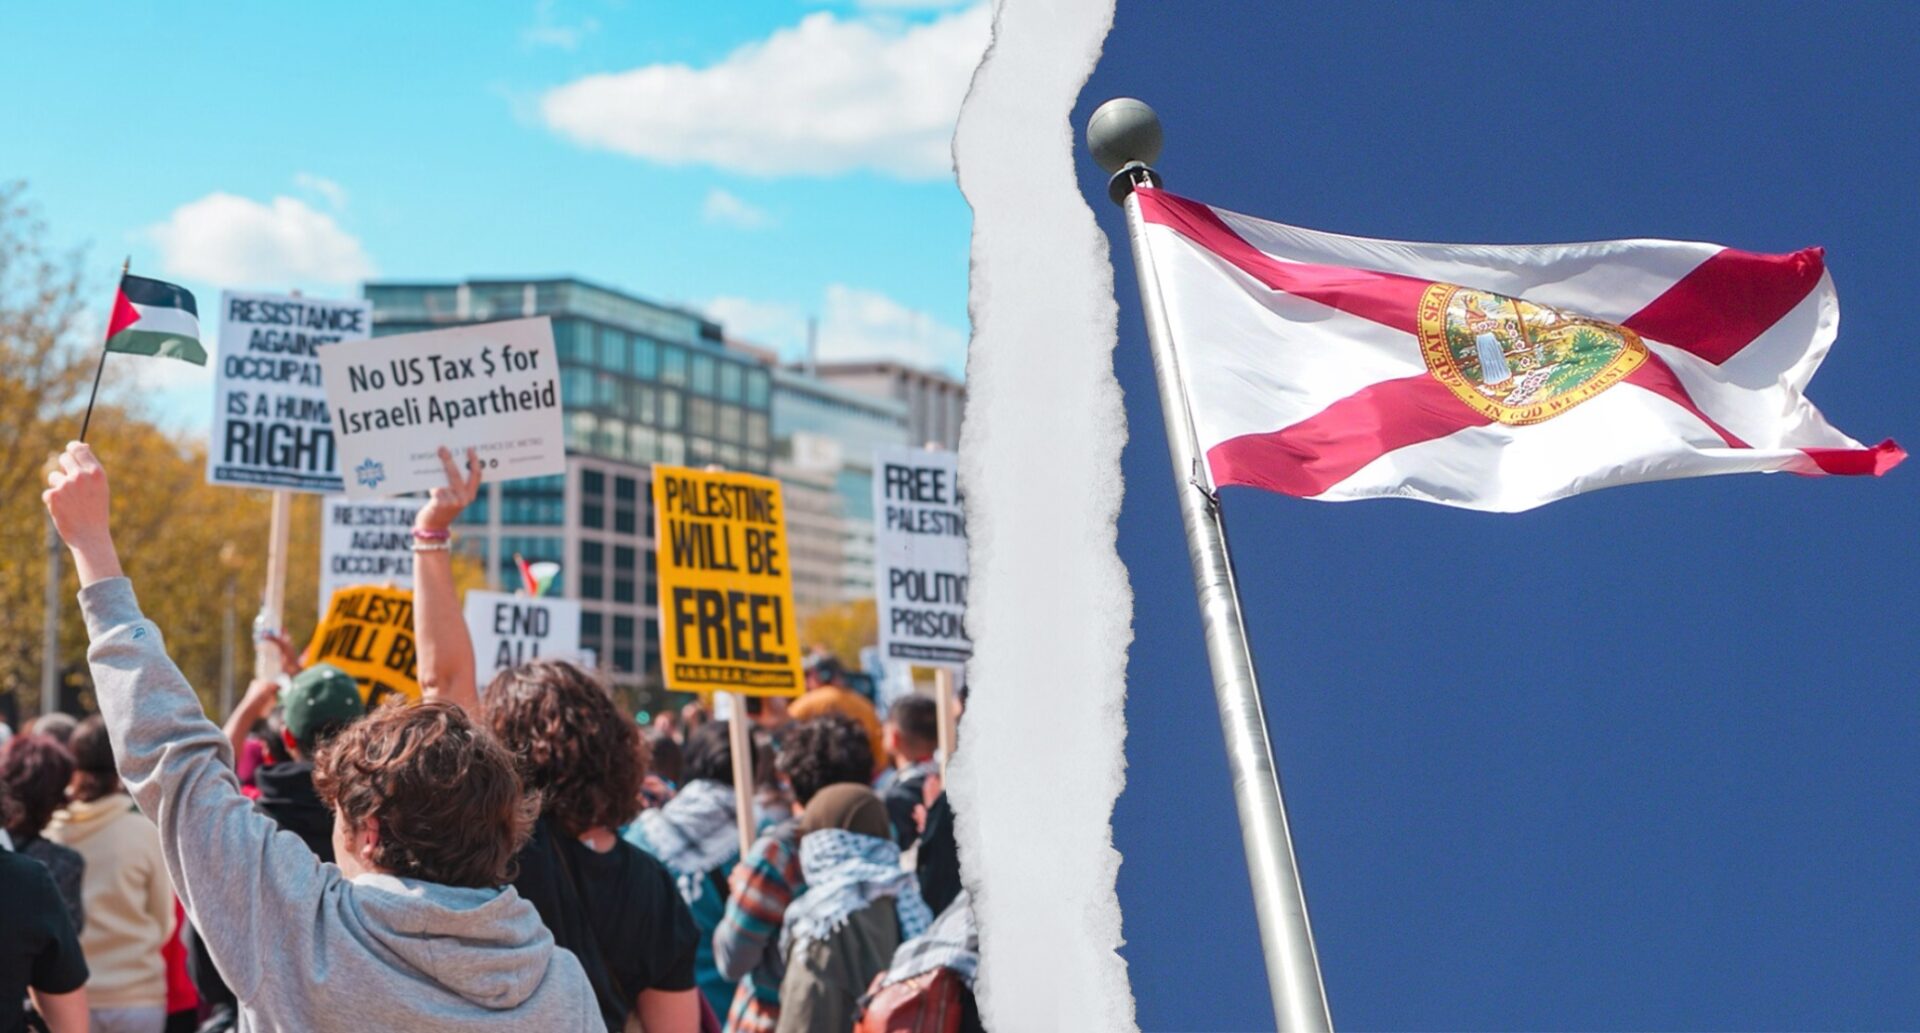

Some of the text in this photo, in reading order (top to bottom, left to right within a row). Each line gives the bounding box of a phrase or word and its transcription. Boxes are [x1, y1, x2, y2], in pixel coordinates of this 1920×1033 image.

[229, 298, 364, 333] RESISTANCE
[348, 344, 540, 393] No US Tax $ for
[1582, 366, 1624, 396] TRUST
[227, 392, 248, 416] IS
[254, 394, 268, 417] A
[339, 379, 556, 435] Israeli Apartheid
[665, 476, 778, 525] PALESTINE
[885, 463, 947, 505] FREE
[669, 518, 781, 577] WILL BE
[495, 602, 550, 638] END
[672, 585, 789, 664] FREE!
